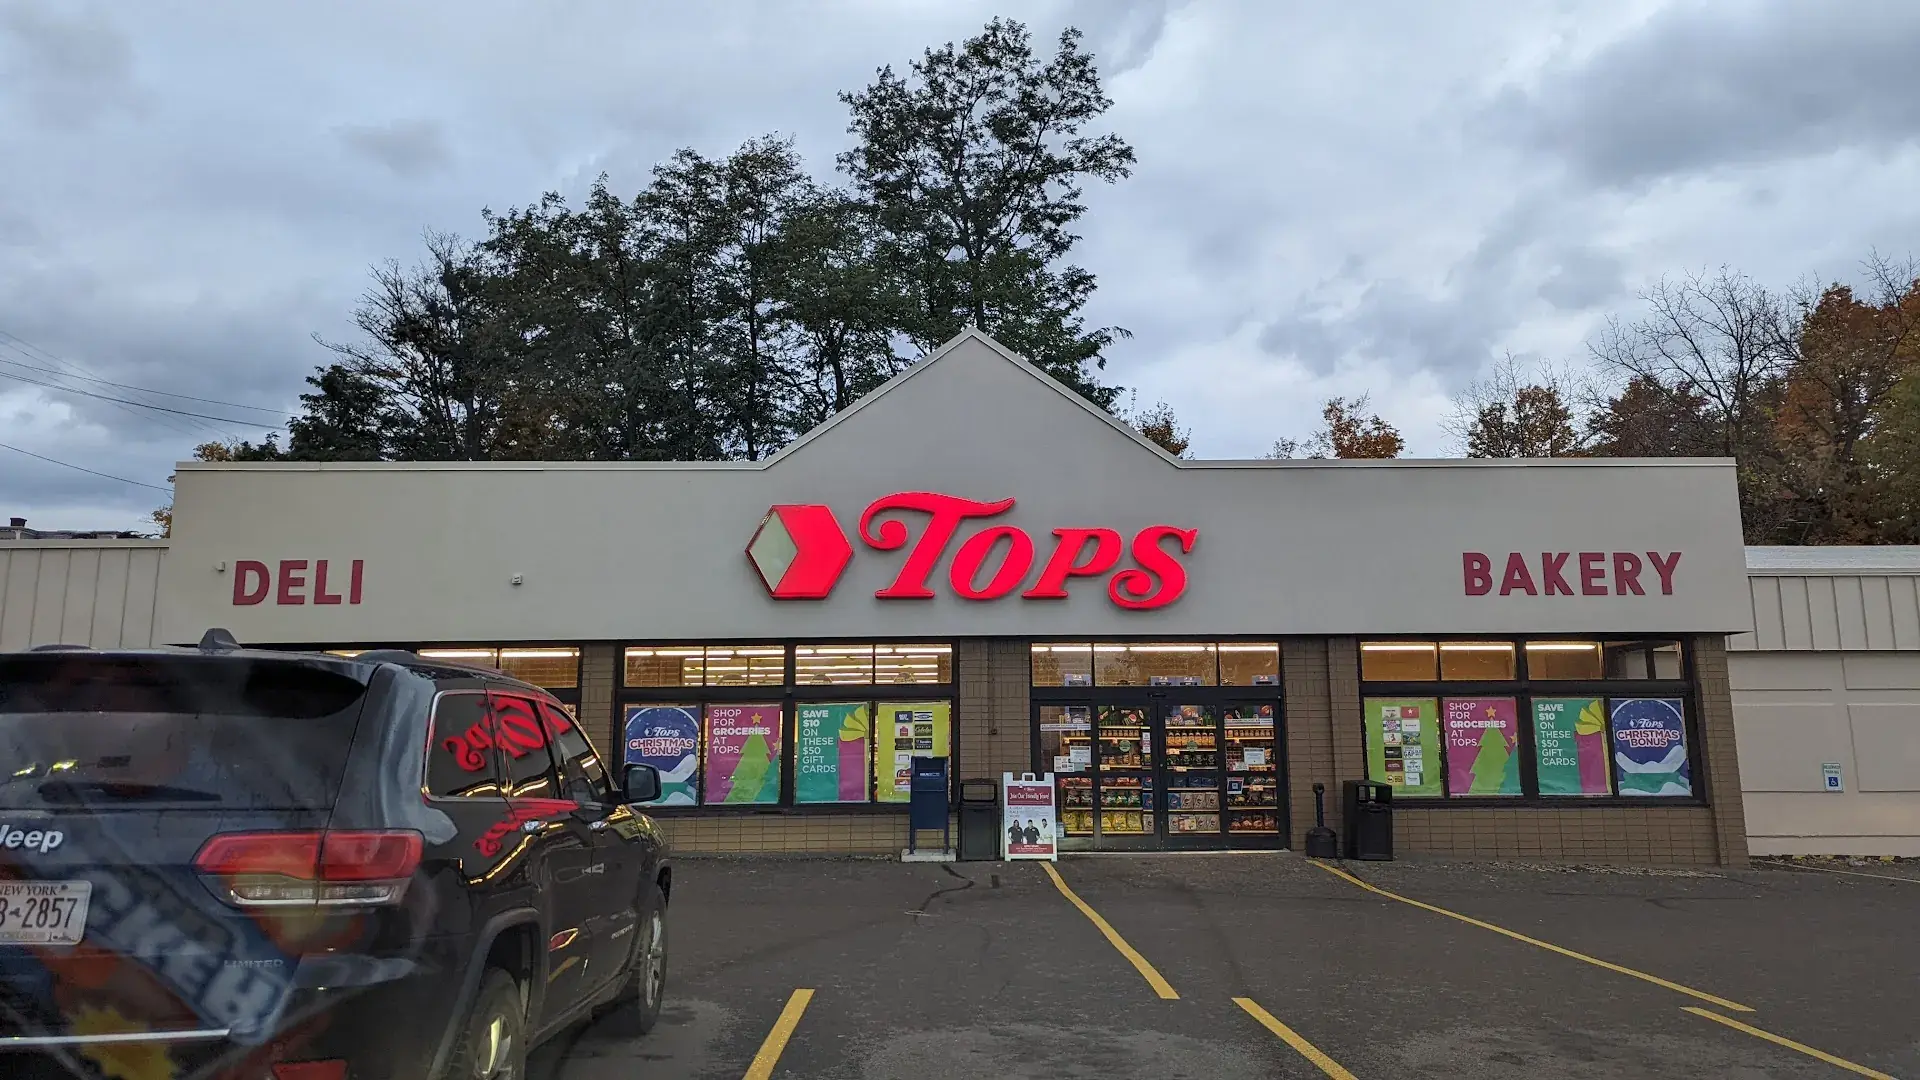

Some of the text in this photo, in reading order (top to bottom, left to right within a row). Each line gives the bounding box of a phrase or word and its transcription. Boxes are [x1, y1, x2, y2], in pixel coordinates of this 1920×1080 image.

[1463, 551, 1681, 597] BAKERY
[234, 560, 363, 605] DELI
[1449, 703, 1476, 711] SHOP
[1538, 704, 1564, 712] SAVE
[713, 709, 742, 718] SHOP
[803, 710, 829, 718] SAVE
[1449, 712, 1470, 720] FOR
[1538, 713, 1555, 721] $10
[713, 718, 735, 727] FOR
[803, 719, 820, 728] $10
[1450, 721, 1507, 729] GROCERIES
[1540, 722, 1554, 730] ON
[713, 727, 771, 736] GROCERIES
[1451, 730, 1463, 738] AT
[1541, 731, 1571, 739] THESE
[1617, 729, 1680, 741] CHRISTMAS
[629, 738, 694, 749] CHRISTMAS
[713, 737, 727, 745] AT
[803, 738, 834, 746] THESE
[1451, 739, 1477, 747] TOPS
[1541, 740, 1558, 748] $50
[1630, 738, 1668, 748] BONUS
[642, 747, 681, 757] BONUS
[713, 746, 740, 754] TOPS
[803, 747, 821, 755] $50
[1542, 749, 1563, 757] GIFT
[803, 756, 825, 764] GIFT
[1543, 758, 1576, 766] CARDS
[802, 765, 836, 773] CARDS
[26, 885, 59, 896] YORK
[223, 958, 284, 969] LIMITED
